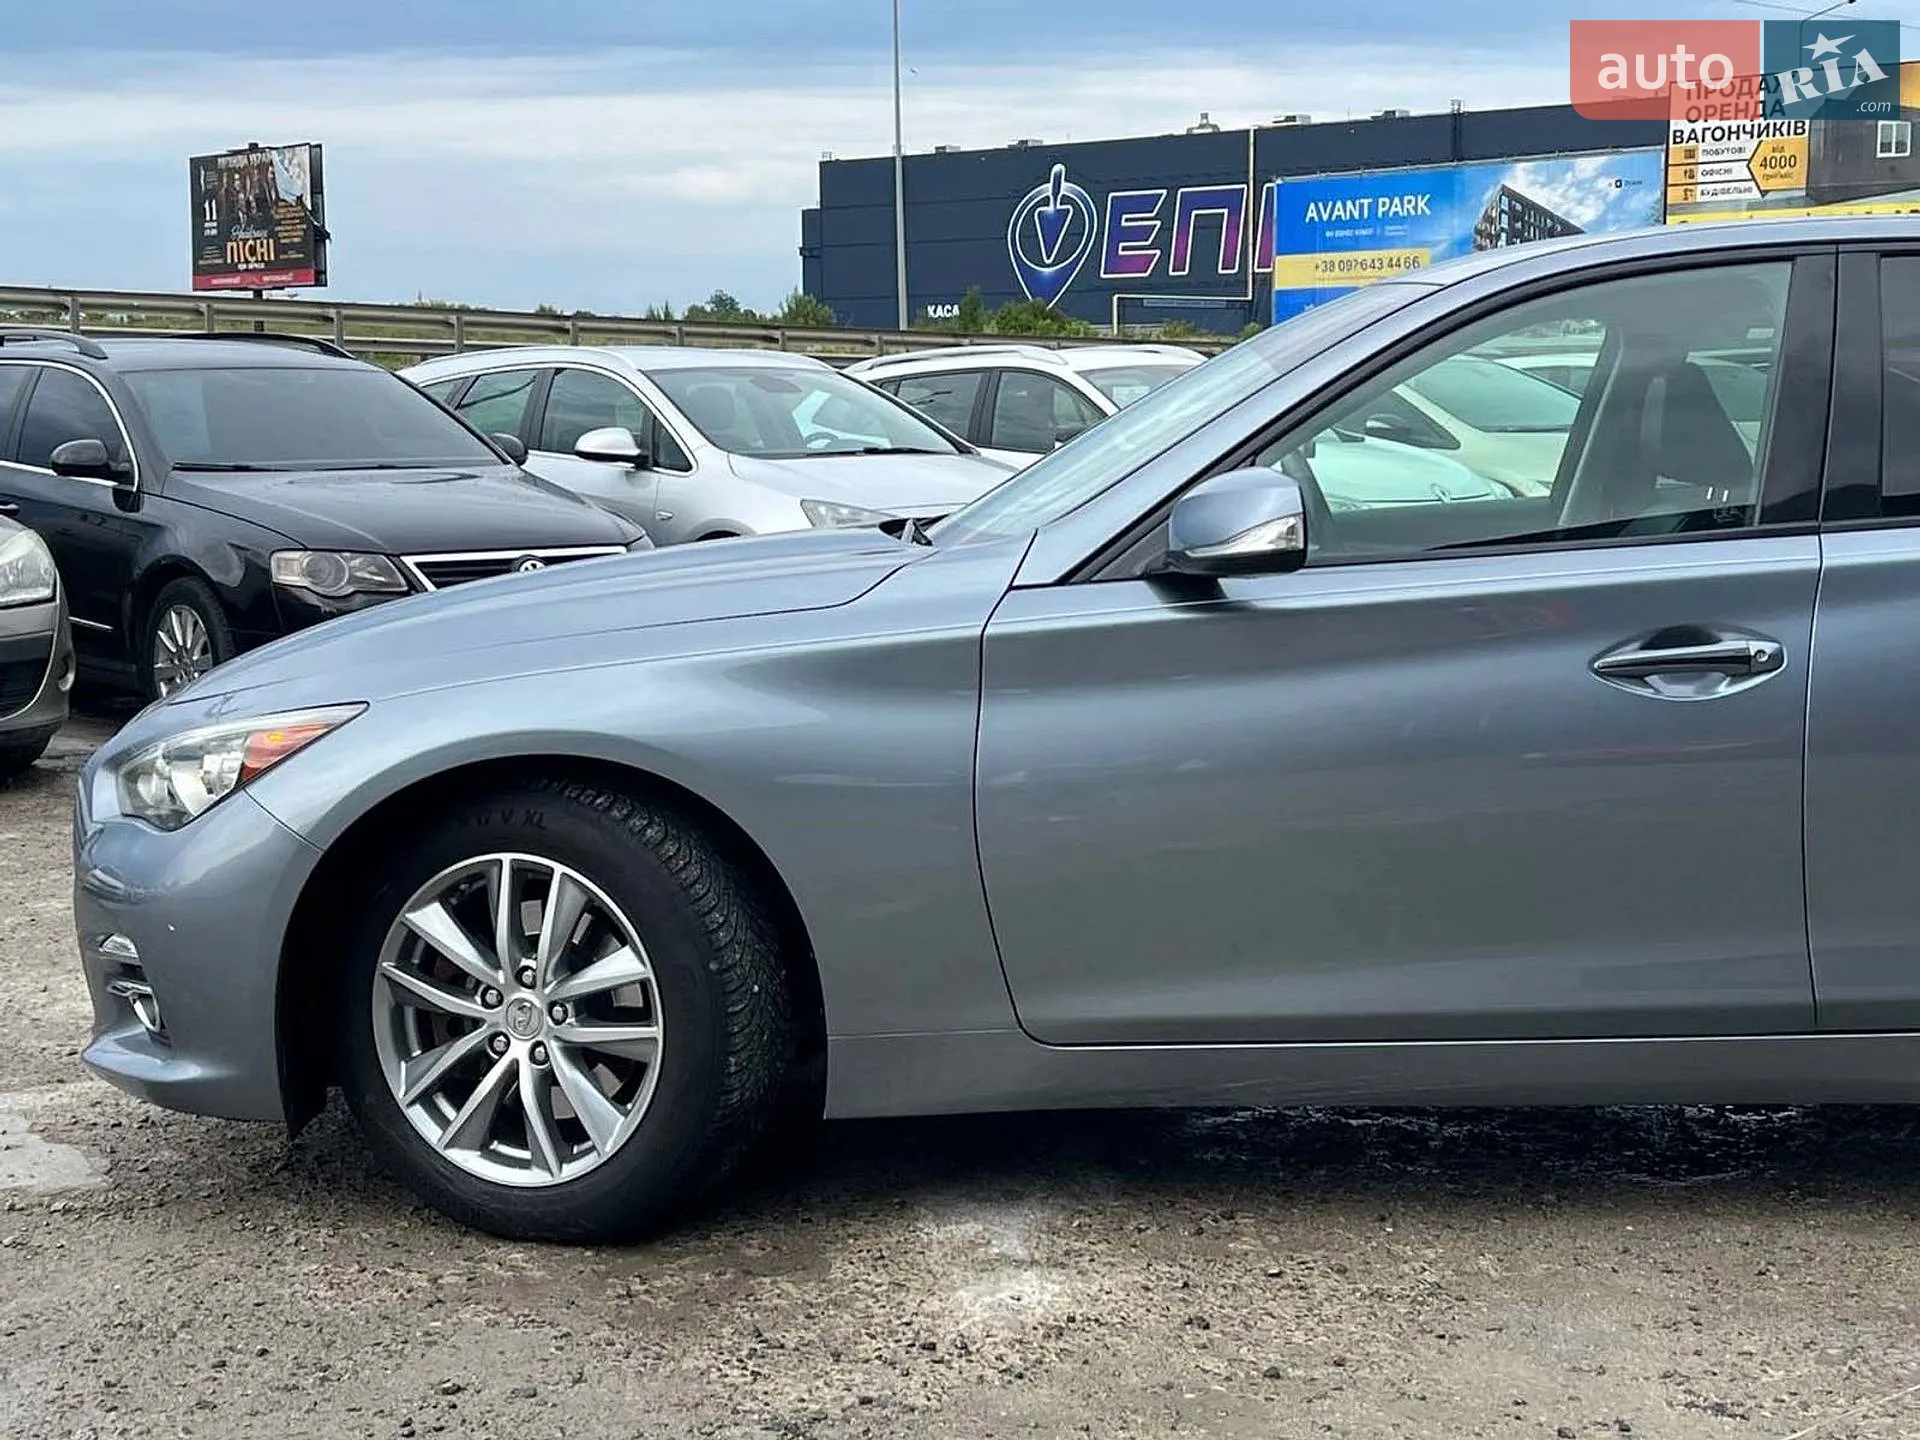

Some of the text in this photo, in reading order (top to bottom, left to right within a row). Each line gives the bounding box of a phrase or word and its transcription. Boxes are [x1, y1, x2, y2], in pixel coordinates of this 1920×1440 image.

[1685, 98, 1787, 123] ОРЕНДА
[1671, 119, 1806, 145] ВАГОНЧИКІВ
[1759, 154, 1797, 170] 4000
[203, 199, 218, 221] 11
[1305, 193, 1432, 224] AVANT PARK
[226, 238, 275, 264] ПІСНІ
[1315, 260, 1336, 272] +38
[927, 304, 961, 318] КАСА
